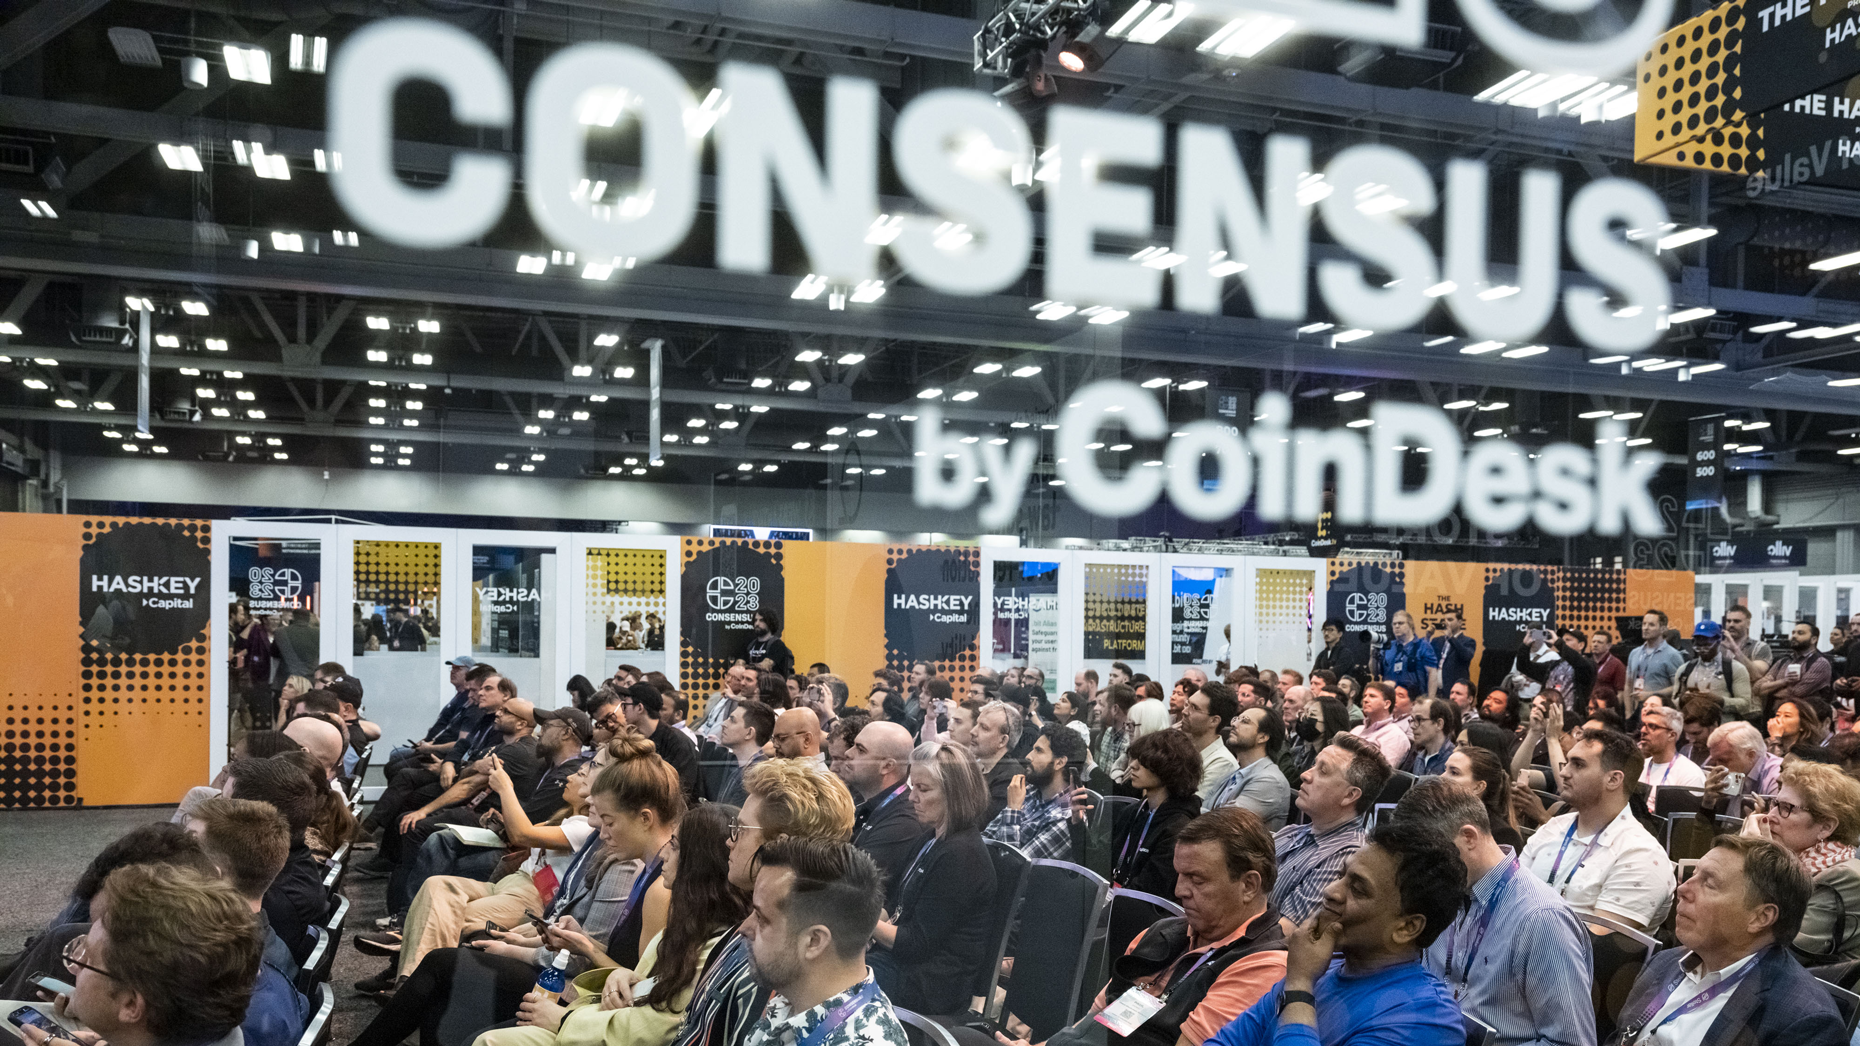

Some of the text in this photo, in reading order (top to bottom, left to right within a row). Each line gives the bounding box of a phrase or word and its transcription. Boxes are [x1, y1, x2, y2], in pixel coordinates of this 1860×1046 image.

[1758, 0, 1811, 33] THE
[1825, 15, 1860, 49] HA
[325, 15, 1672, 352] CONSENSUS
[912, 380, 1668, 538] by CoinDesk
[1696, 450, 1716, 462] 600
[1696, 466, 1715, 478] 500
[91, 575, 201, 594] HASHKEY
[735, 576, 760, 593] 20
[148, 597, 193, 609] Capital
[735, 594, 759, 610] 23
[893, 594, 973, 610] HASHKEY
[1368, 593, 1387, 608] 20
[1368, 608, 1387, 623] 23
[1424, 603, 1464, 615] HASH
[1489, 607, 1550, 621] HASHKEY
[706, 612, 754, 622] CONSENSU
[934, 612, 967, 623] Capital
[1345, 624, 1387, 632] CONSENSUS
[1103, 639, 1145, 650] PLATFORM
